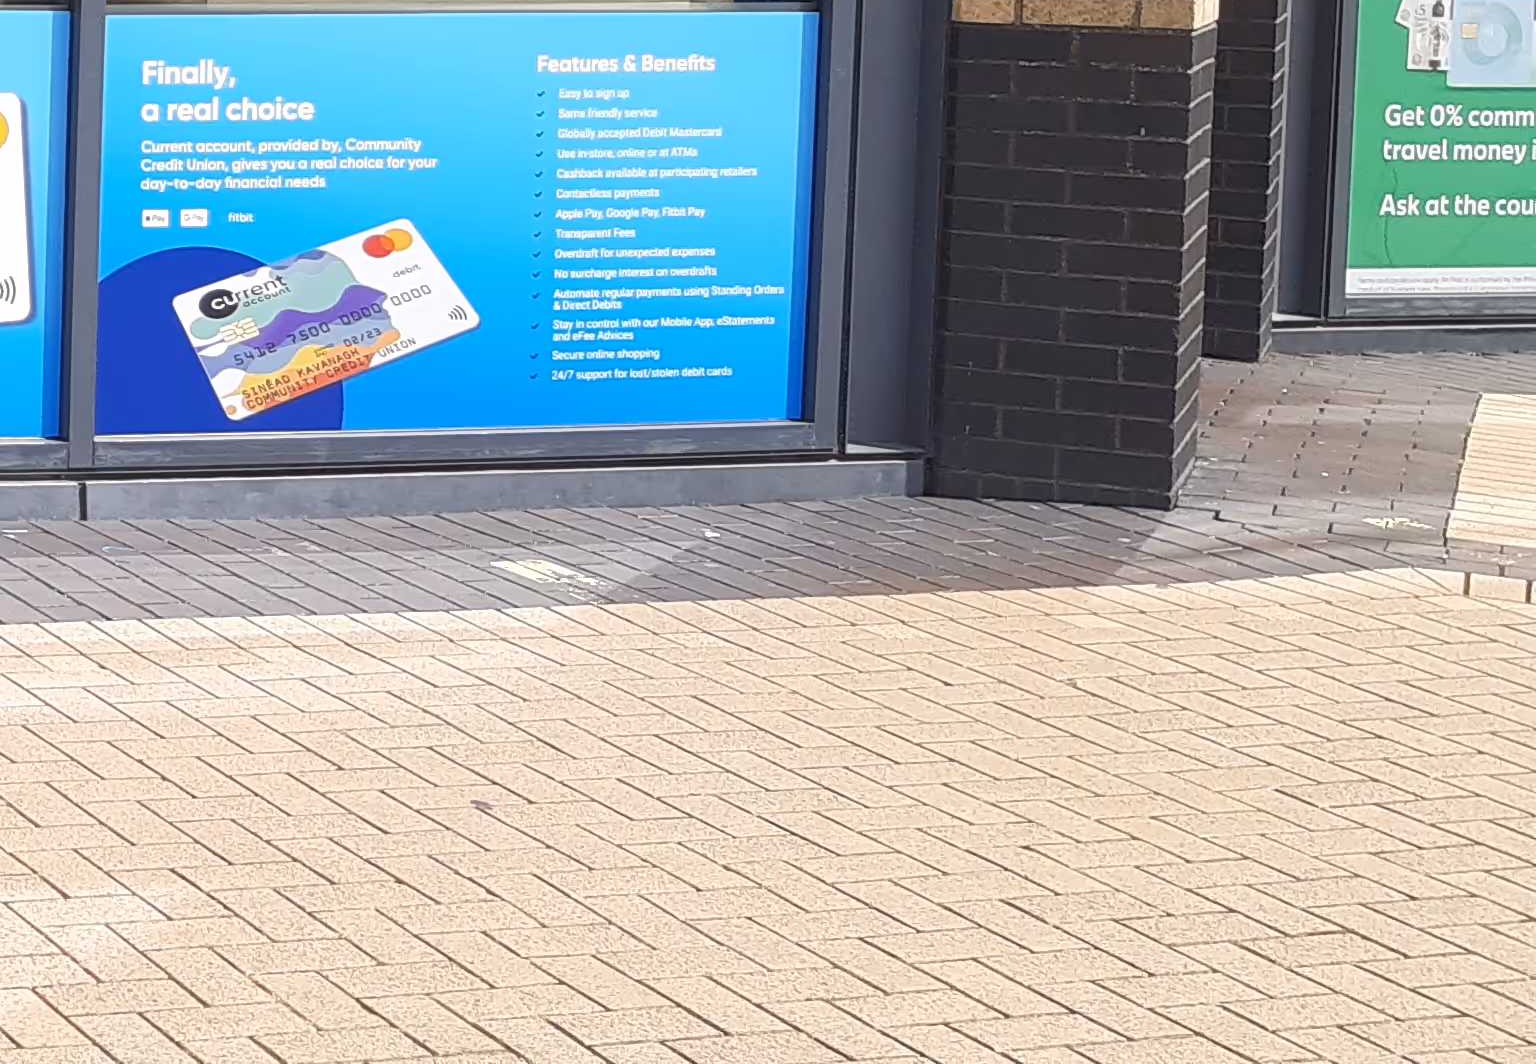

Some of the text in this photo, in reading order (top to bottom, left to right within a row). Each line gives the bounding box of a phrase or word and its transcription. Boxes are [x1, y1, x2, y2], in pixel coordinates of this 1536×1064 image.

[537, 53, 716, 73] Features & Benefits
[141, 59, 236, 90] Finally,
[140, 96, 316, 122] a real choice
[1384, 104, 1535, 127] Get 0% comm
[141, 137, 422, 154] Current account, provided by, Community
[1383, 138, 1448, 160] travel
[1453, 143, 1527, 165] money
[140, 155, 438, 174] Credit Union, gives you a real choice for your
[140, 174, 327, 193] day-to-day financial needs
[1379, 194, 1536, 216] Ask at the cou
[227, 212, 255, 223] fitbit
[555, 227, 637, 240] Transparent Fees
[554, 247, 716, 259] Overdraft for unexpected expenses
[392, 263, 422, 278] debit
[210, 274, 289, 310] current
[242, 287, 291, 308] account
[553, 284, 785, 299] Automate regular payments using Standing Orders
[553, 299, 622, 311] & Direct Debits
[233, 284, 433, 366] 5412 7500 0000 0000
[552, 319, 574, 330] Stay
[576, 319, 585, 328] in
[588, 318, 619, 328] control
[621, 318, 642, 328] with
[643, 319, 659, 327] our
[661, 317, 692, 327] Mobile
[716, 316, 775, 326] eStatements
[342, 327, 383, 348] 02/23
[552, 330, 634, 341] and eFee Advices
[296, 347, 361, 378] KAVANAGH
[552, 348, 660, 360] Secure online shopping
[245, 337, 418, 411] COMMUNITY CREDIT UNION
[551, 366, 733, 381] 24/7 support for lost/stolen debit cards
